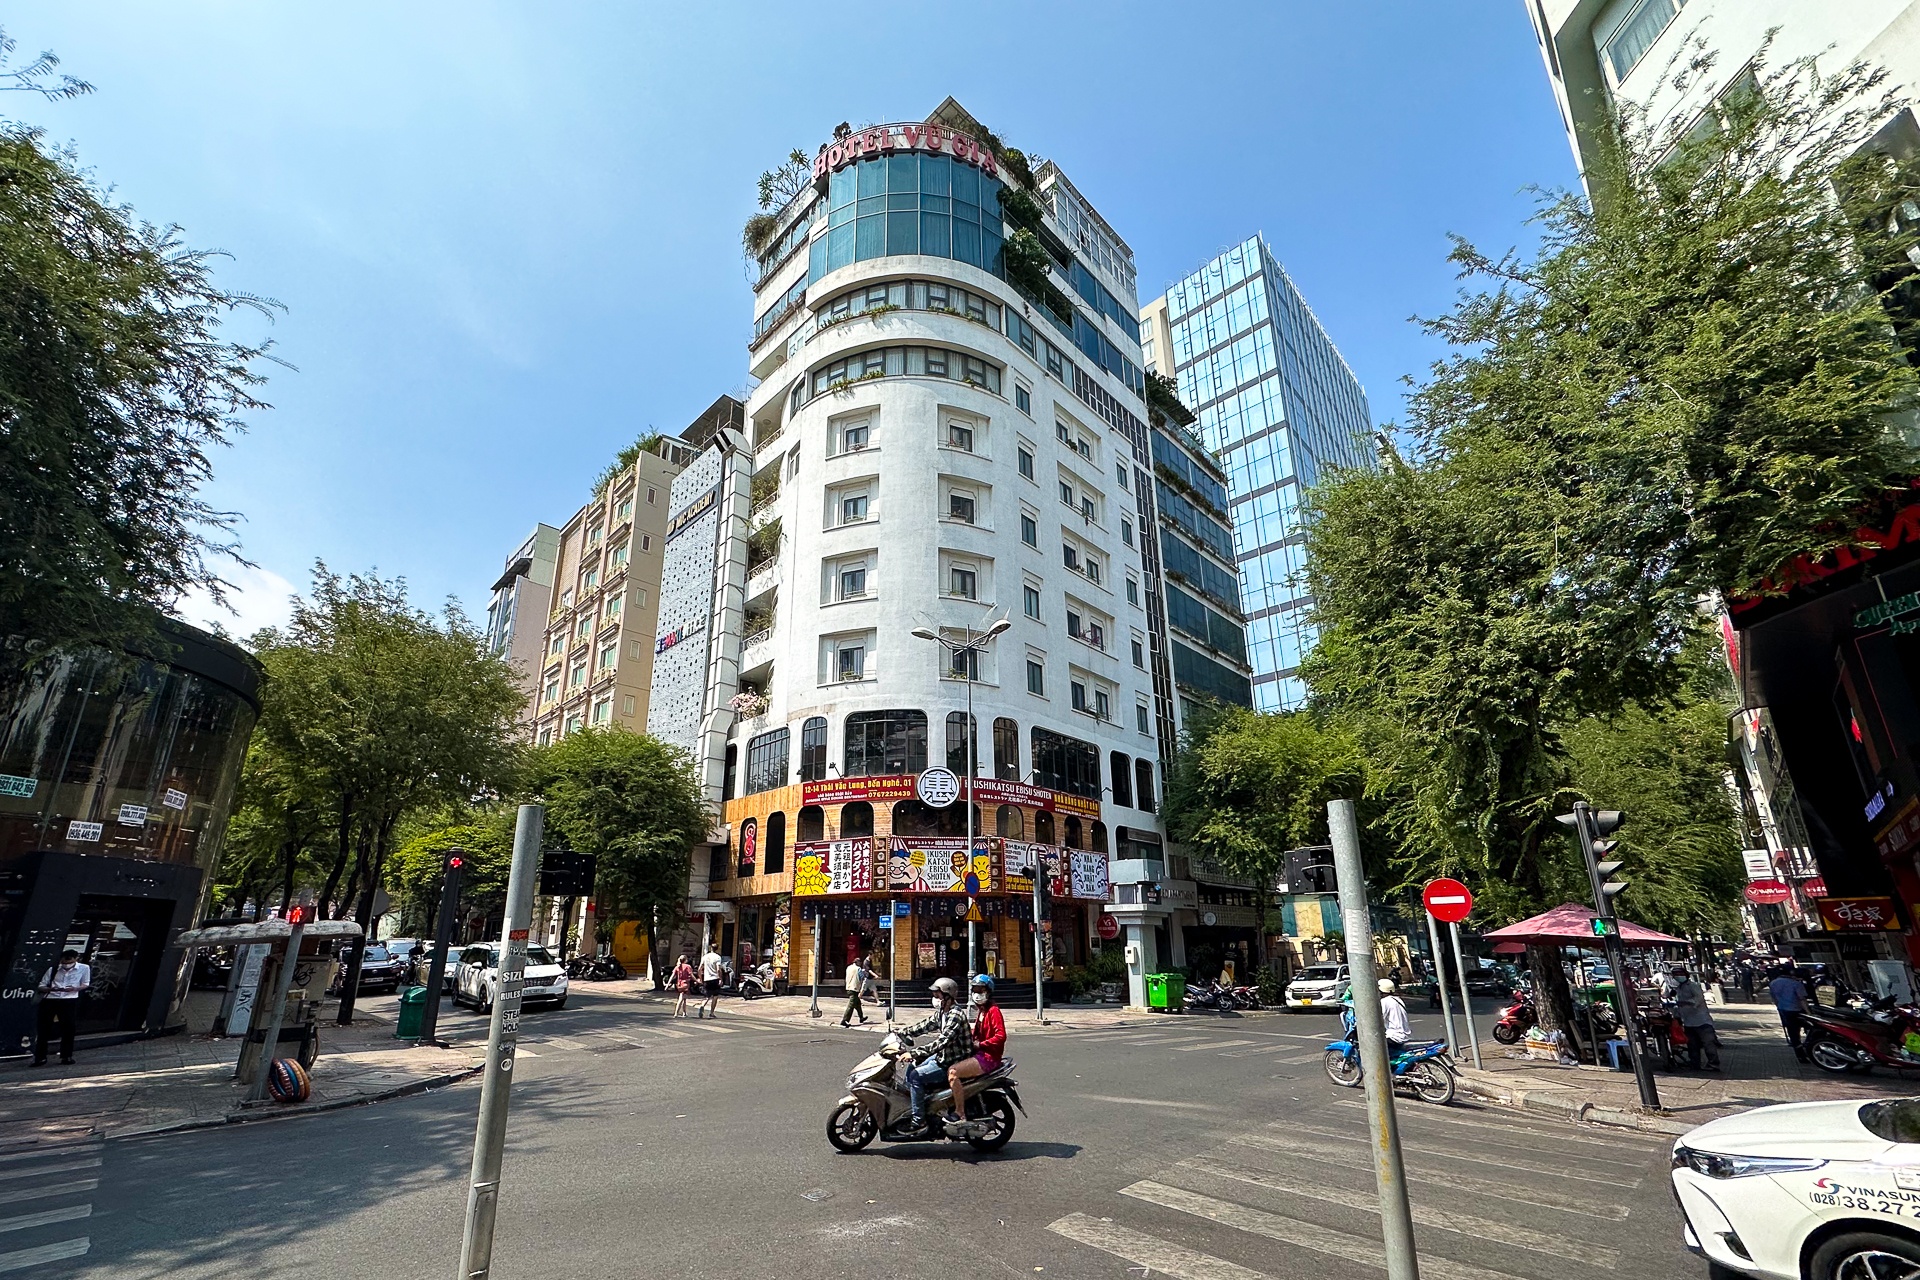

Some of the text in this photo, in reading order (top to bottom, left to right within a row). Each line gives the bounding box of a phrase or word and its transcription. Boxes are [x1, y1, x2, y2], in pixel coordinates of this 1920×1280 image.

[812, 129, 895, 179] HOTEL
[951, 134, 998, 175] GIA
[971, 781, 1015, 793] USHIKATSU
[1015, 785, 1033, 796] EBISU
[1032, 788, 1052, 800] SHOTEN
[929, 850, 951, 858] KUSHI
[842, 843, 851, 889] 元祖串かつ
[852, 841, 862, 889] パラダイス
[927, 858, 950, 866] KATSU
[929, 865, 949, 873] EBISU
[926, 873, 951, 881] SHOTEN
[1834, 902, 1884, 923] すき家
[501, 990, 521, 1001] RULES
